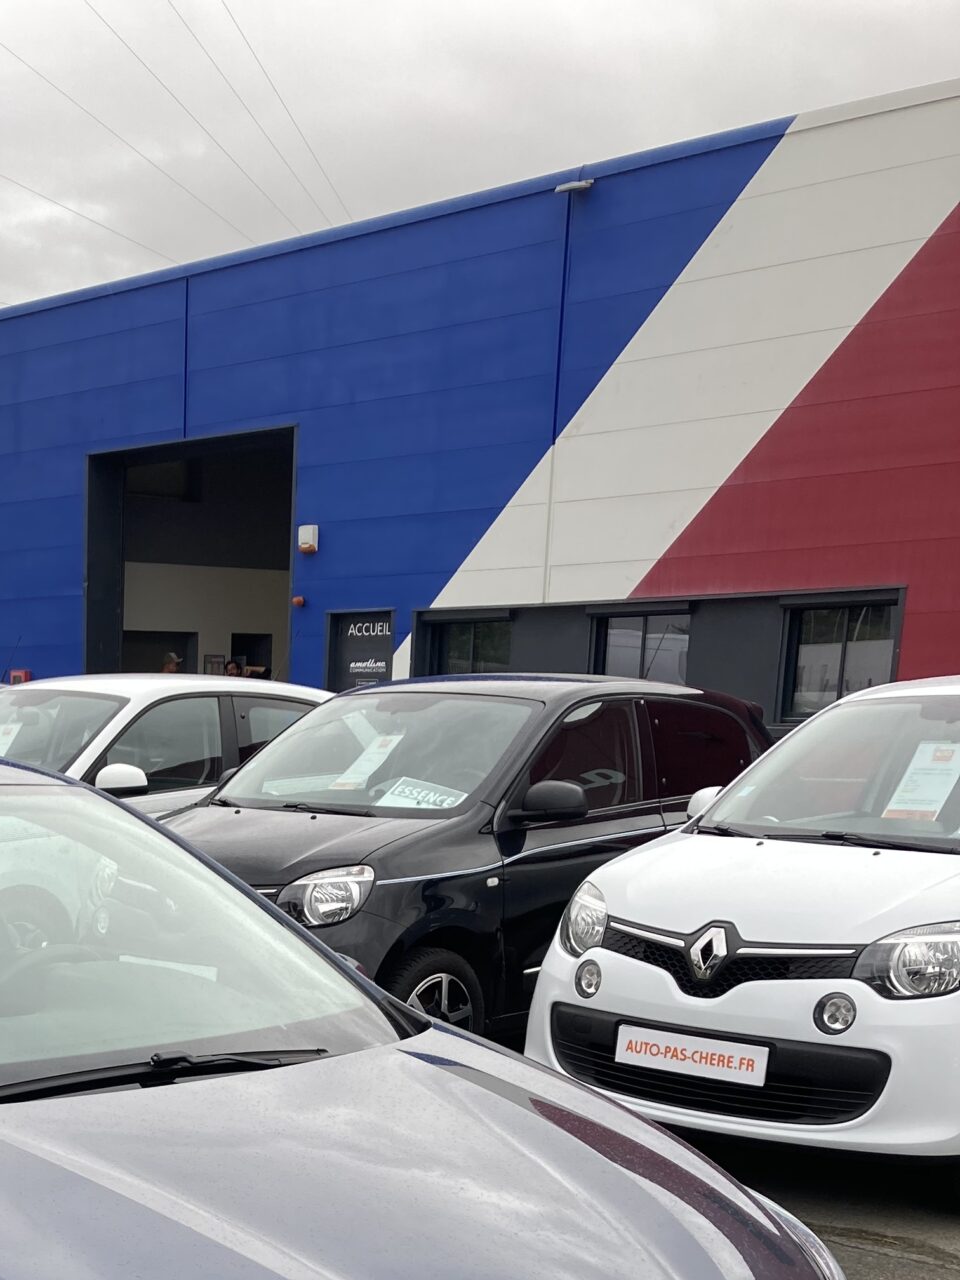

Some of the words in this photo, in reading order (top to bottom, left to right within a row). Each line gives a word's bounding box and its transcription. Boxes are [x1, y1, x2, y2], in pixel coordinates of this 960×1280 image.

[348, 622, 391, 636] ACCUEIL
[393, 785, 456, 808] ESSENCE
[625, 1039, 756, 1073] AUTO-PAS-CHERE.FR
